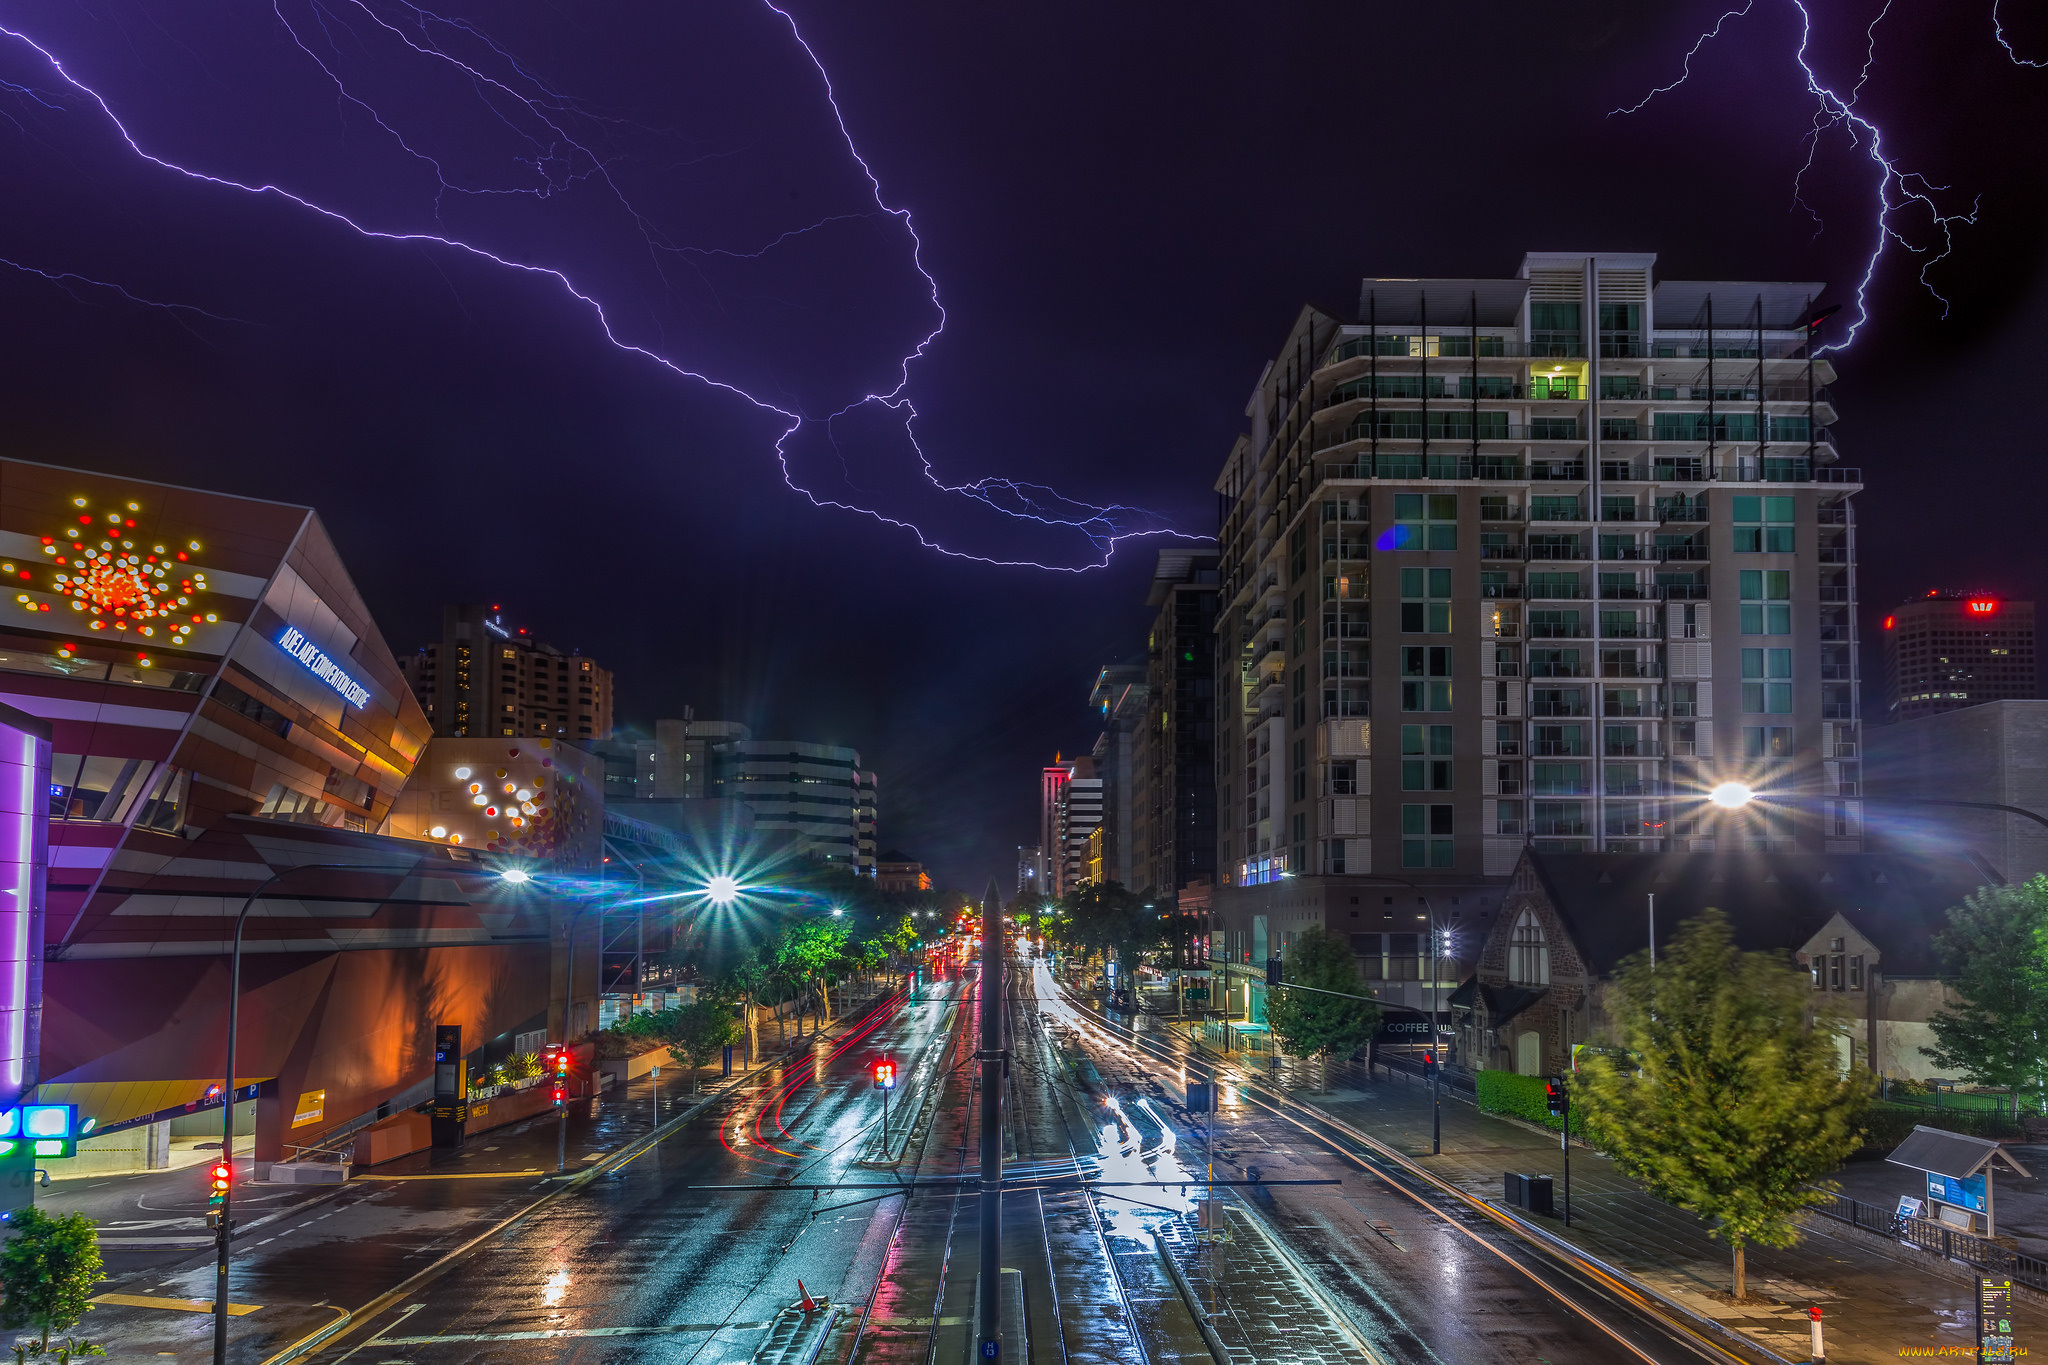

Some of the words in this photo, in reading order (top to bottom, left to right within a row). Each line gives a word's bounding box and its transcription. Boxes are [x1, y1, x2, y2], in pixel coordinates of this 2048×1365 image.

[279, 627, 319, 667] ADELAIDE
[311, 653, 353, 694] CONVENTION
[344, 681, 370, 709] CENTRE
[1387, 1023, 1429, 1032] COFFEE
[250, 1085, 256, 1096] P
